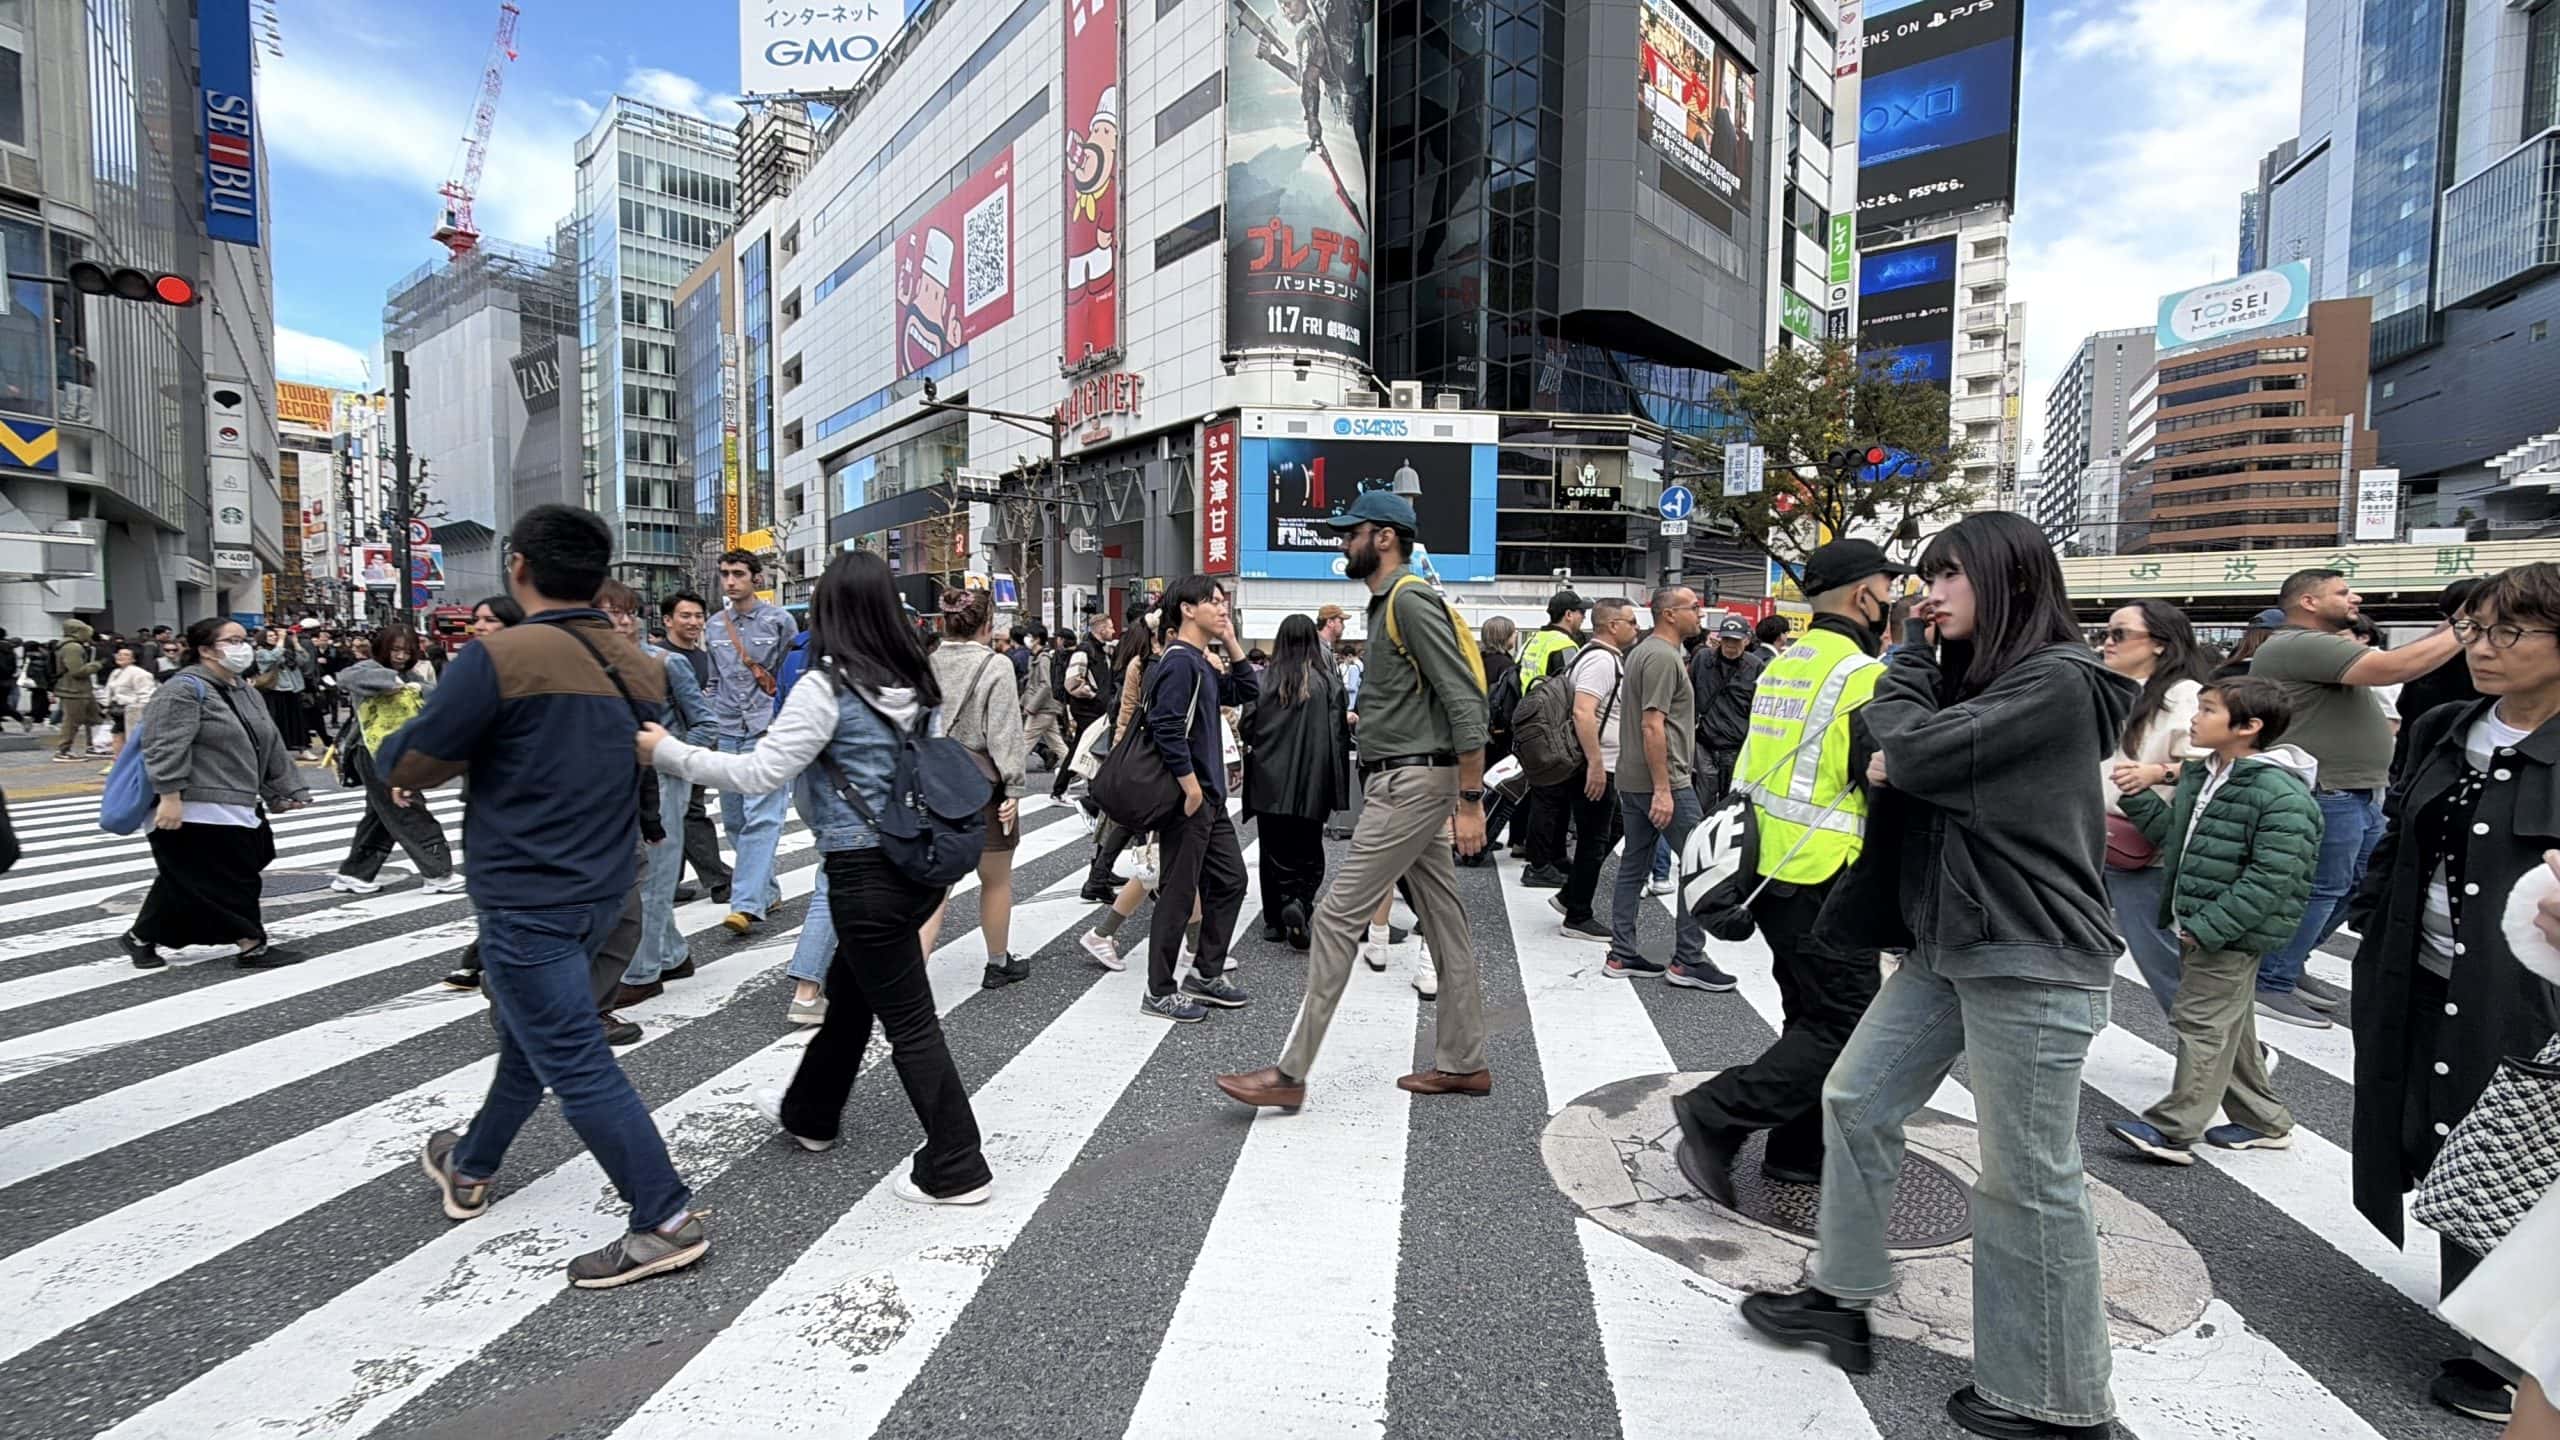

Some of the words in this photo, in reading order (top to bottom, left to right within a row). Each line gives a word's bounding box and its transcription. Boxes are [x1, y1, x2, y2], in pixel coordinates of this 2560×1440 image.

[764, 3, 879, 28] インターネット
[1897, 20, 1920, 37] ON
[1950, 0, 1994, 20] PS5
[764, 35, 879, 66] GMO
[206, 89, 252, 216] SEIBU
[1247, 216, 1370, 282] プレデター
[1834, 222, 1848, 255] レイク
[1274, 275, 1359, 301] バッドランド
[1268, 305, 1300, 333] 11.7
[1302, 316, 1322, 335] FRI
[2191, 291, 2268, 322] TOSEI
[279, 383, 329, 405] TOWER
[516, 358, 560, 400] ZARA
[1055, 372, 1143, 434] MAGNET
[1353, 418, 1408, 437] STARTS
[1208, 449, 1230, 563] 天津甘栗
[1567, 487, 1611, 498] COFFEE
[728, 495, 737, 527] TOUCH
[728, 528, 737, 552] OM'S
[2129, 562, 2161, 581] JR
